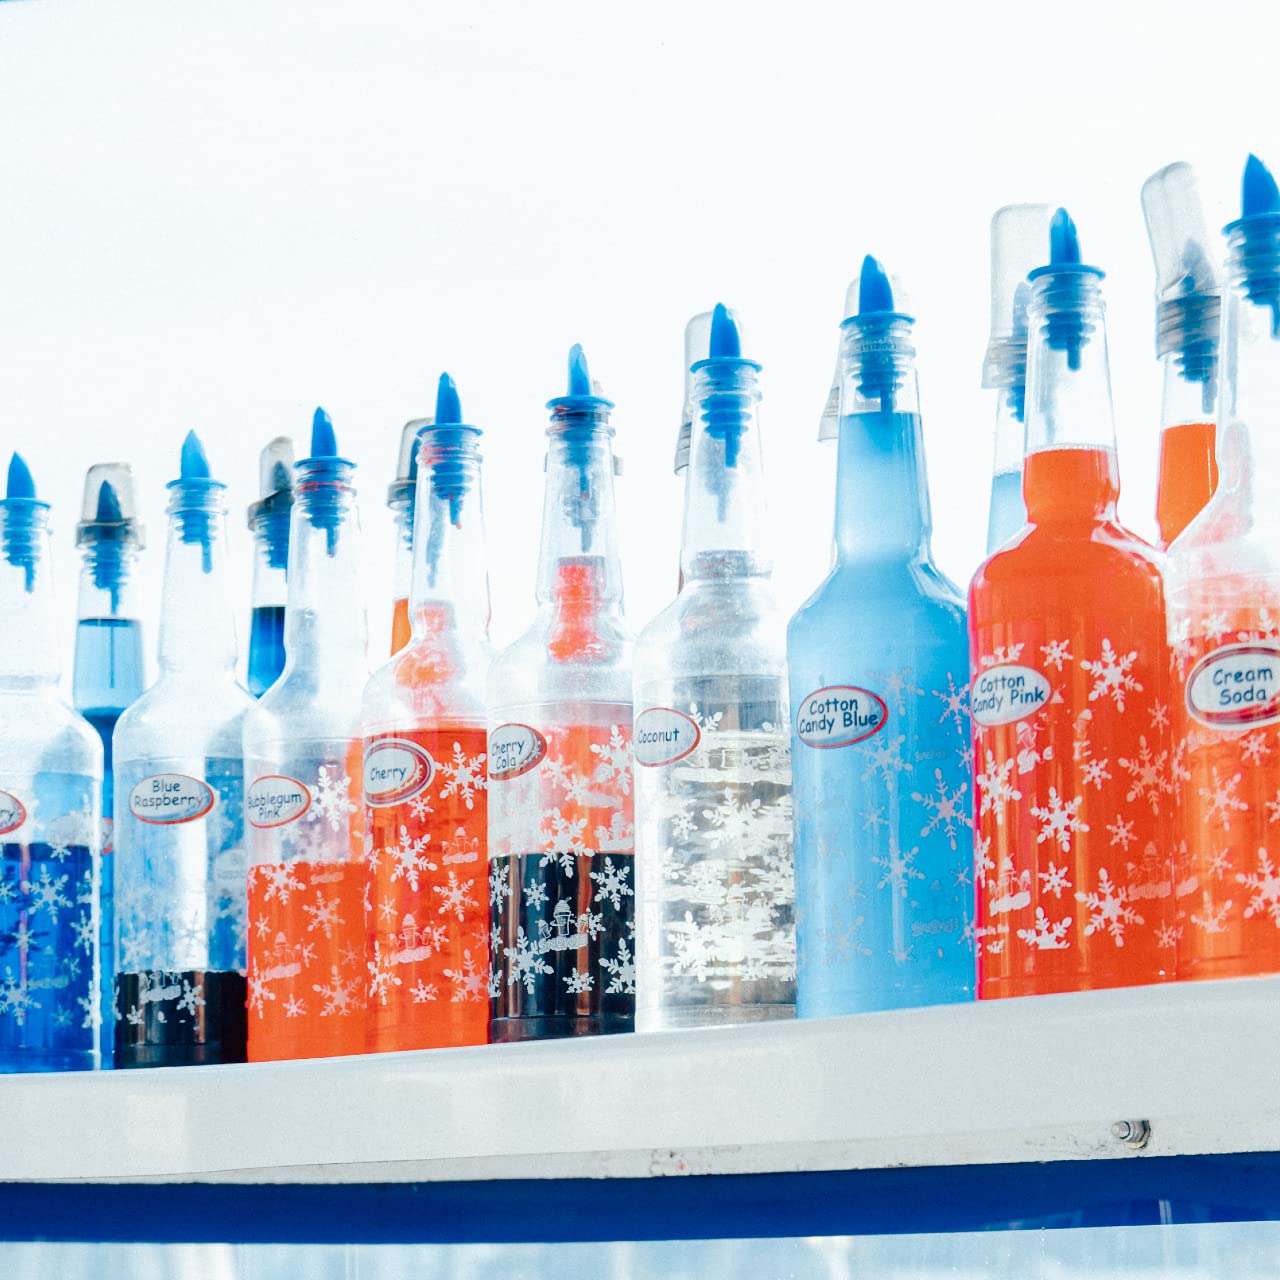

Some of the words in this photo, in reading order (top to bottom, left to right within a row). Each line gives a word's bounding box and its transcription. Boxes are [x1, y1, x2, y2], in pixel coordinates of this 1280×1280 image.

[980, 674, 1025, 693] Cotton
[1212, 667, 1273, 686] Cream
[972, 695, 1004, 713] Candy
[1010, 686, 1045, 705] Pink
[1219, 686, 1267, 705] Soda
[809, 698, 859, 716] Cotton
[799, 717, 835, 735] Candy
[842, 711, 879, 728] Blue
[637, 728, 680, 744] Coconut
[491, 739, 525, 757] Cherry
[496, 756, 517, 770] Cola
[370, 765, 407, 785] Cherry
[152, 780, 181, 792] Blue
[135, 794, 203, 810] Raspberry
[248, 793, 302, 810] Bubblegum
[258, 806, 281, 819] Pink
